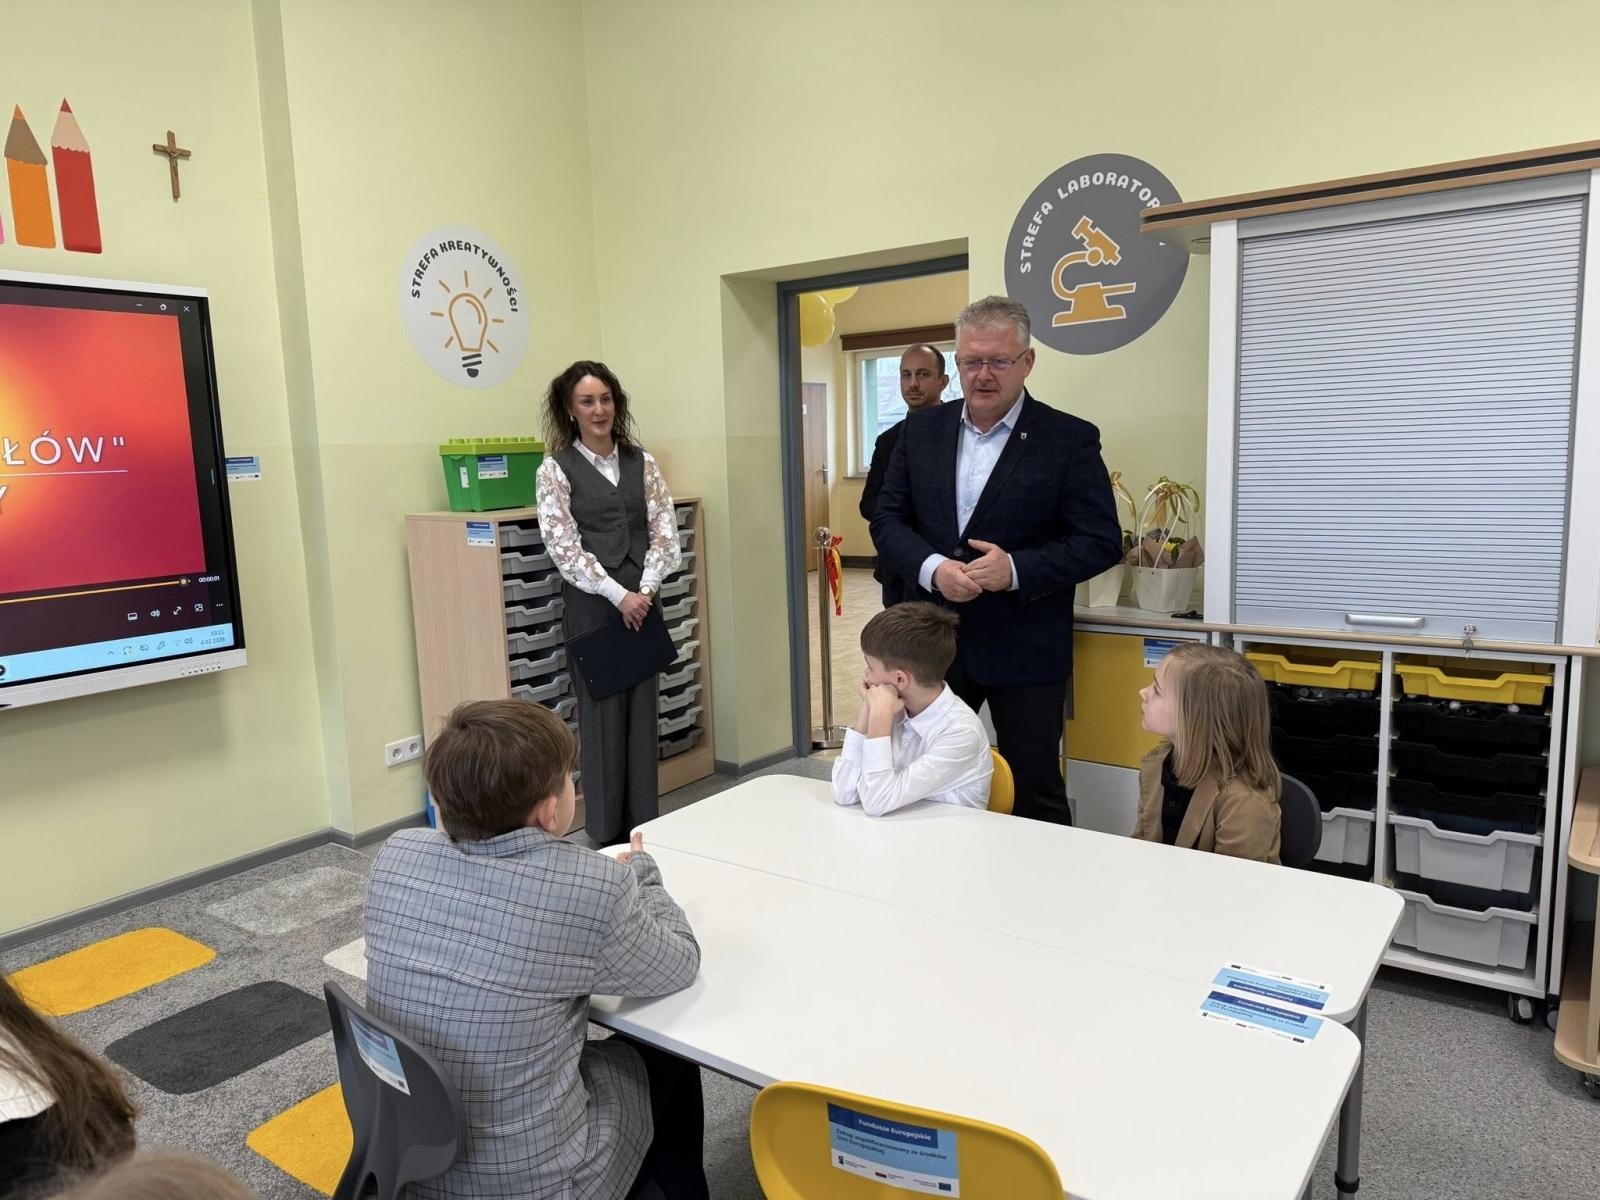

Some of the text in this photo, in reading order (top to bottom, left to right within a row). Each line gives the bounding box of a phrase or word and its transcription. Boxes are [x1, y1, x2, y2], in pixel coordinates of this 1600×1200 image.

[1020, 171, 1161, 274] STREFA LABORATOR
[411, 240, 518, 312] STREFA KREATYWNOŚCI
[858, 1119, 932, 1141] Fundusze Europejskie
